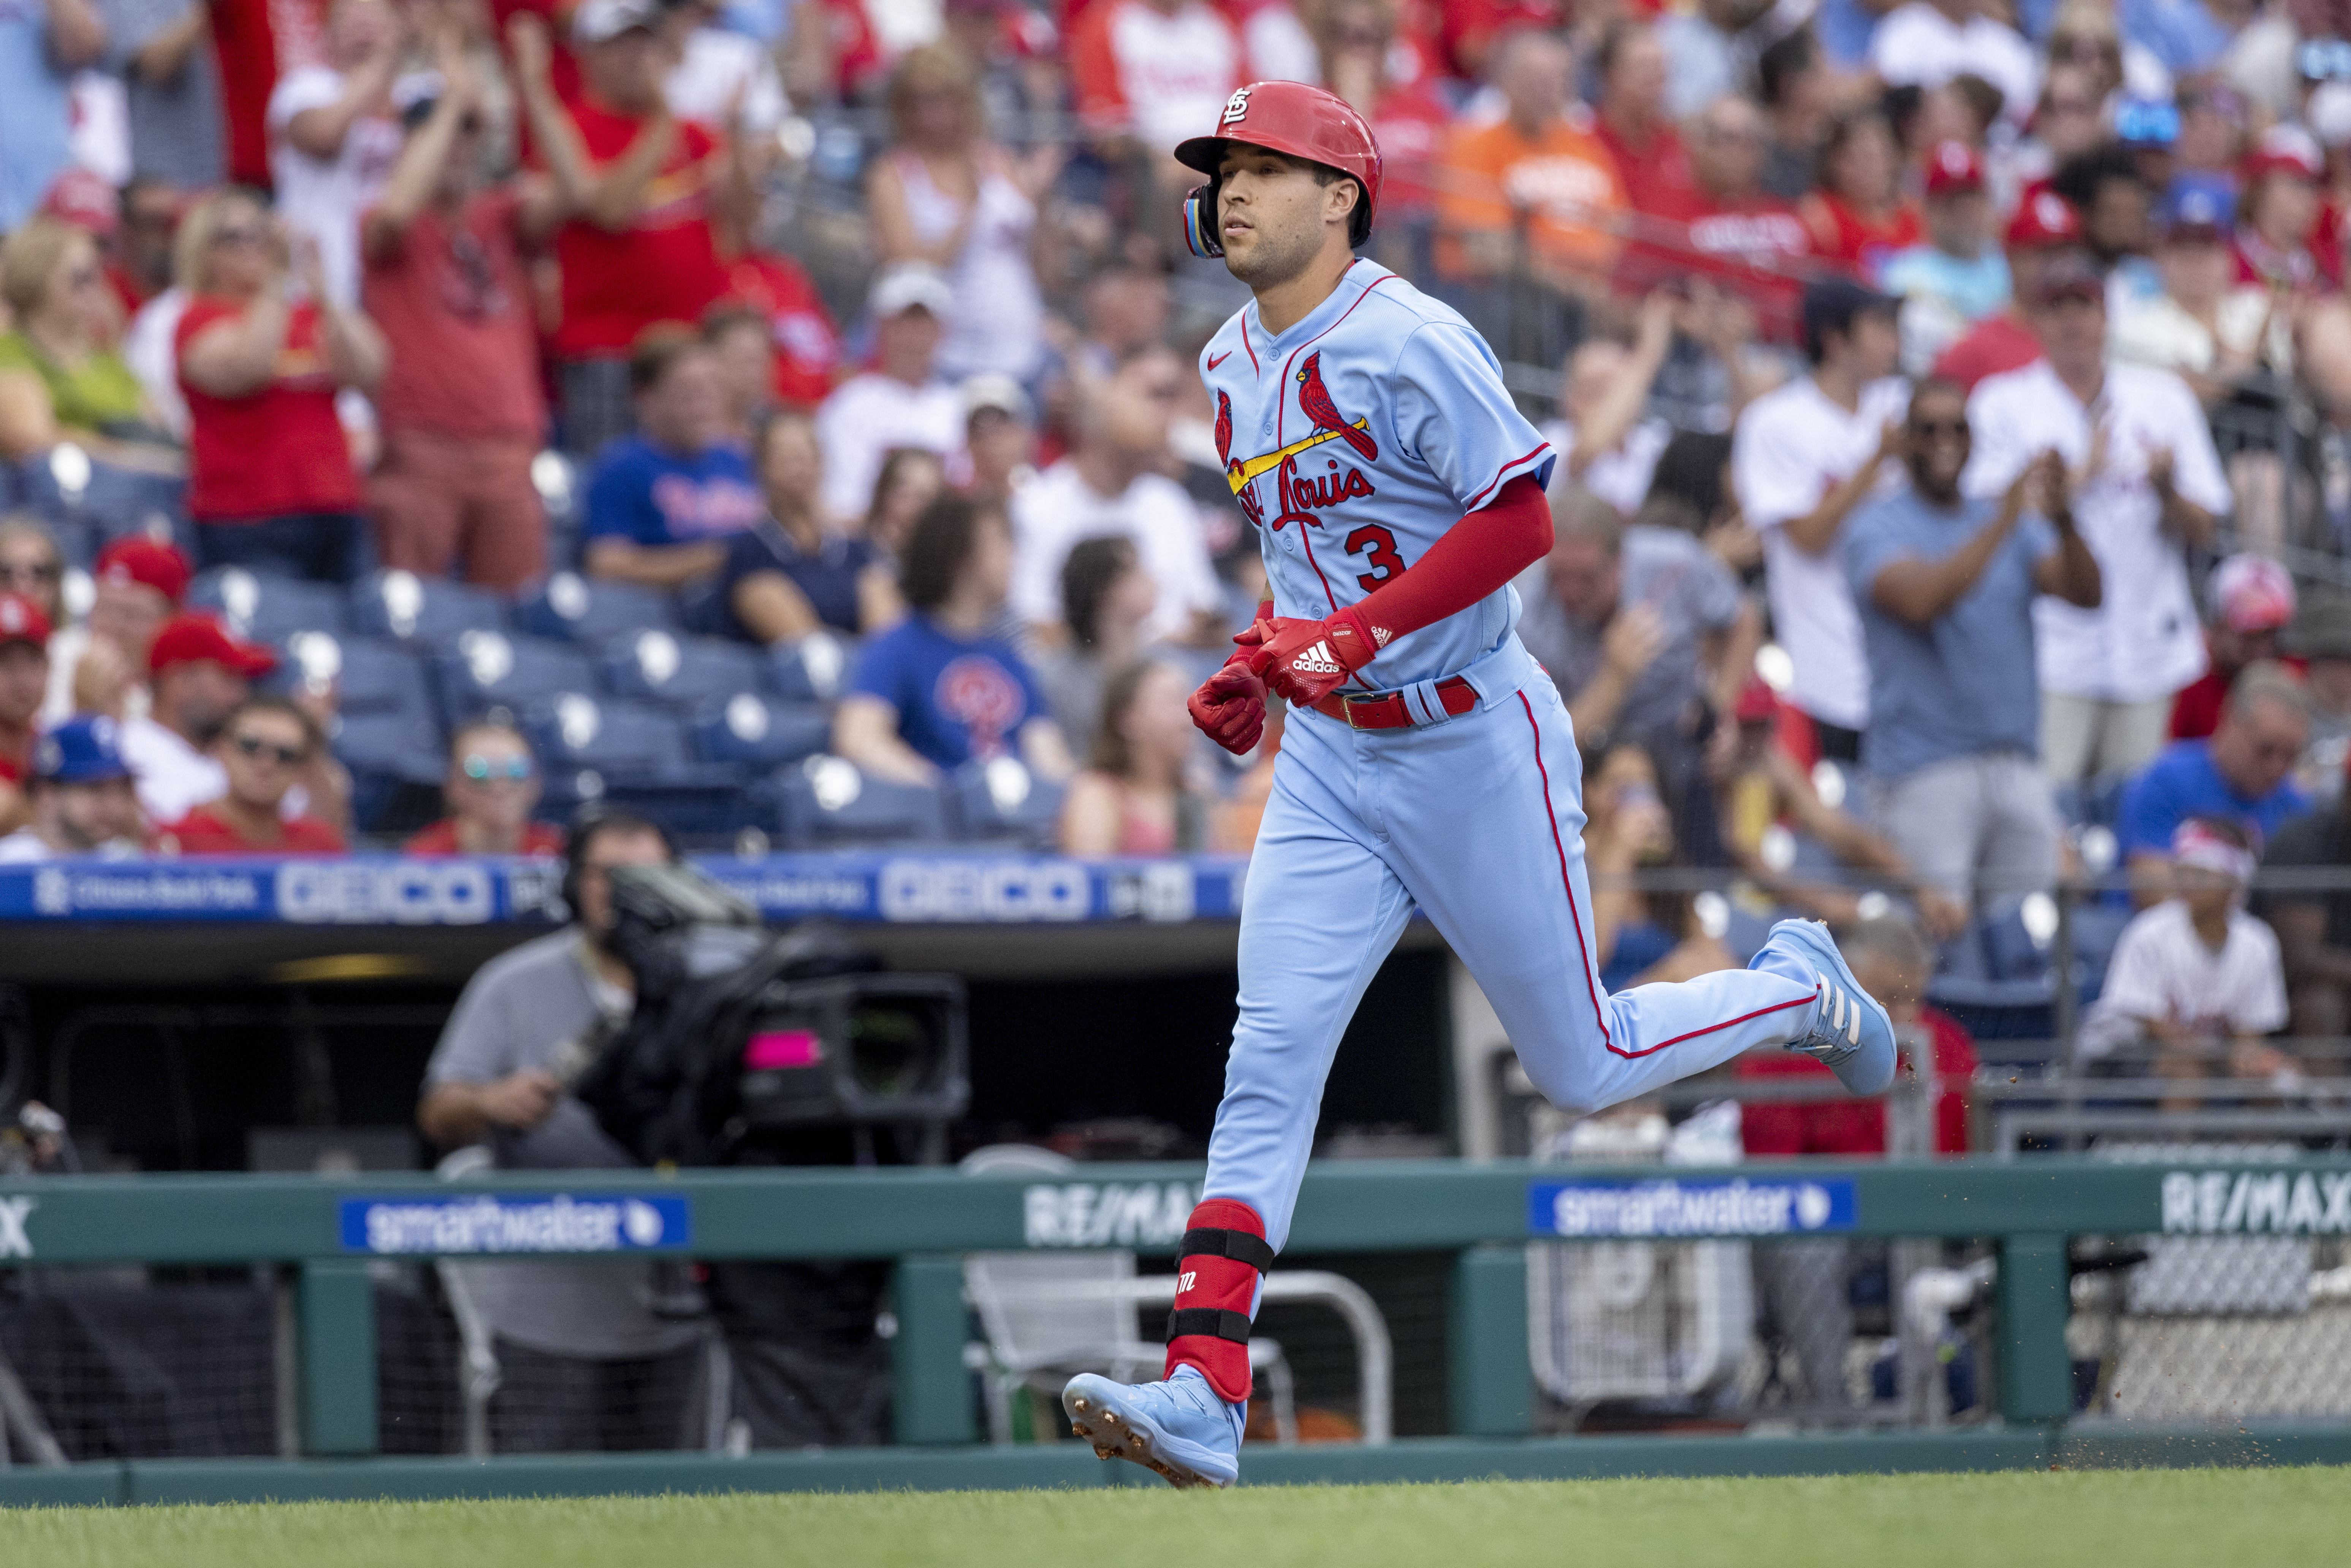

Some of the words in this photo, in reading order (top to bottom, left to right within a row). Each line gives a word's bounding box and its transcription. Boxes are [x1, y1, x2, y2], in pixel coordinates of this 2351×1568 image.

[1272, 454, 1375, 532] Louis
[1344, 523, 1407, 594] 3
[1292, 659, 1340, 673] adidas
[274, 860, 493, 923] GEICO
[879, 860, 1090, 922] GEICO
[366, 1194, 618, 1252] smartwater
[1024, 1182, 1203, 1246] RE/MA
[1554, 1179, 1793, 1236] smartwater
